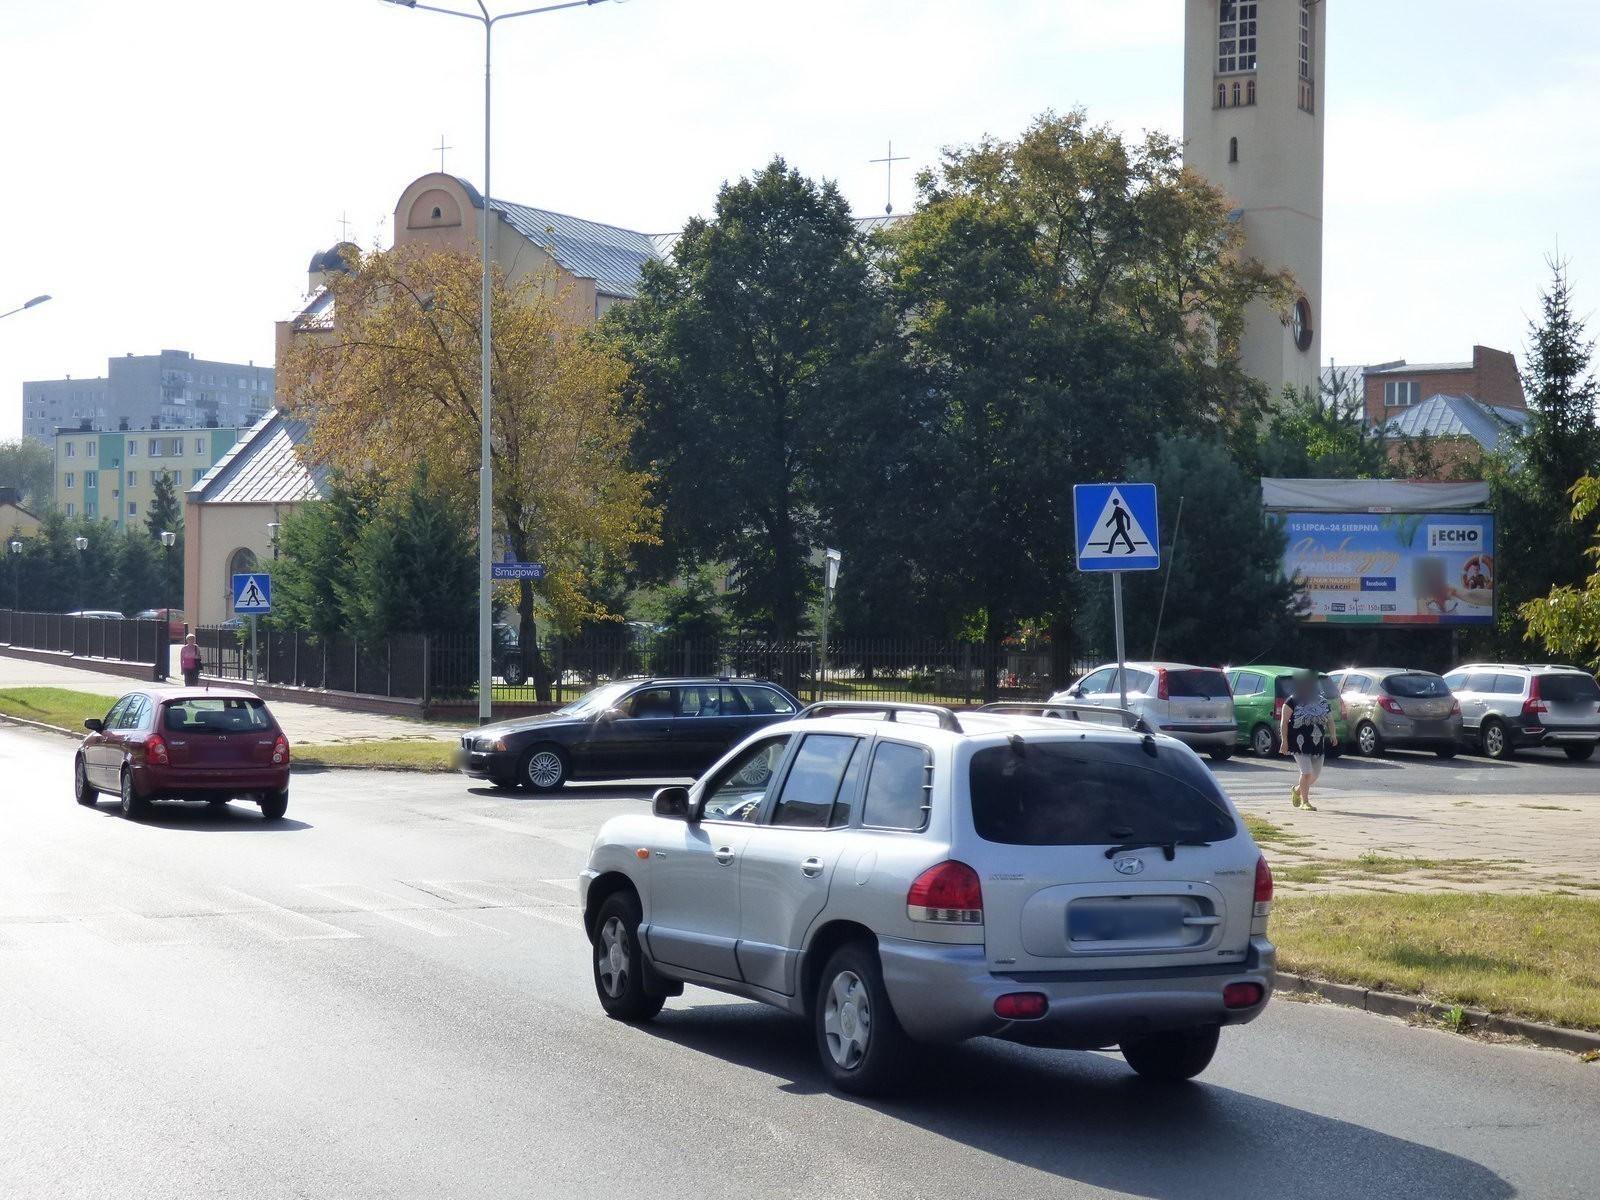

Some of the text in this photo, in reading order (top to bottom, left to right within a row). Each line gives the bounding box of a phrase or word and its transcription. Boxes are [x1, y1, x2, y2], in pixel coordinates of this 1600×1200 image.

[1291, 523, 1301, 532] 15
[1341, 524, 1379, 532] SIERPNIA
[1438, 530, 1478, 541] ECHO
[494, 567, 540, 578] Smugowa
